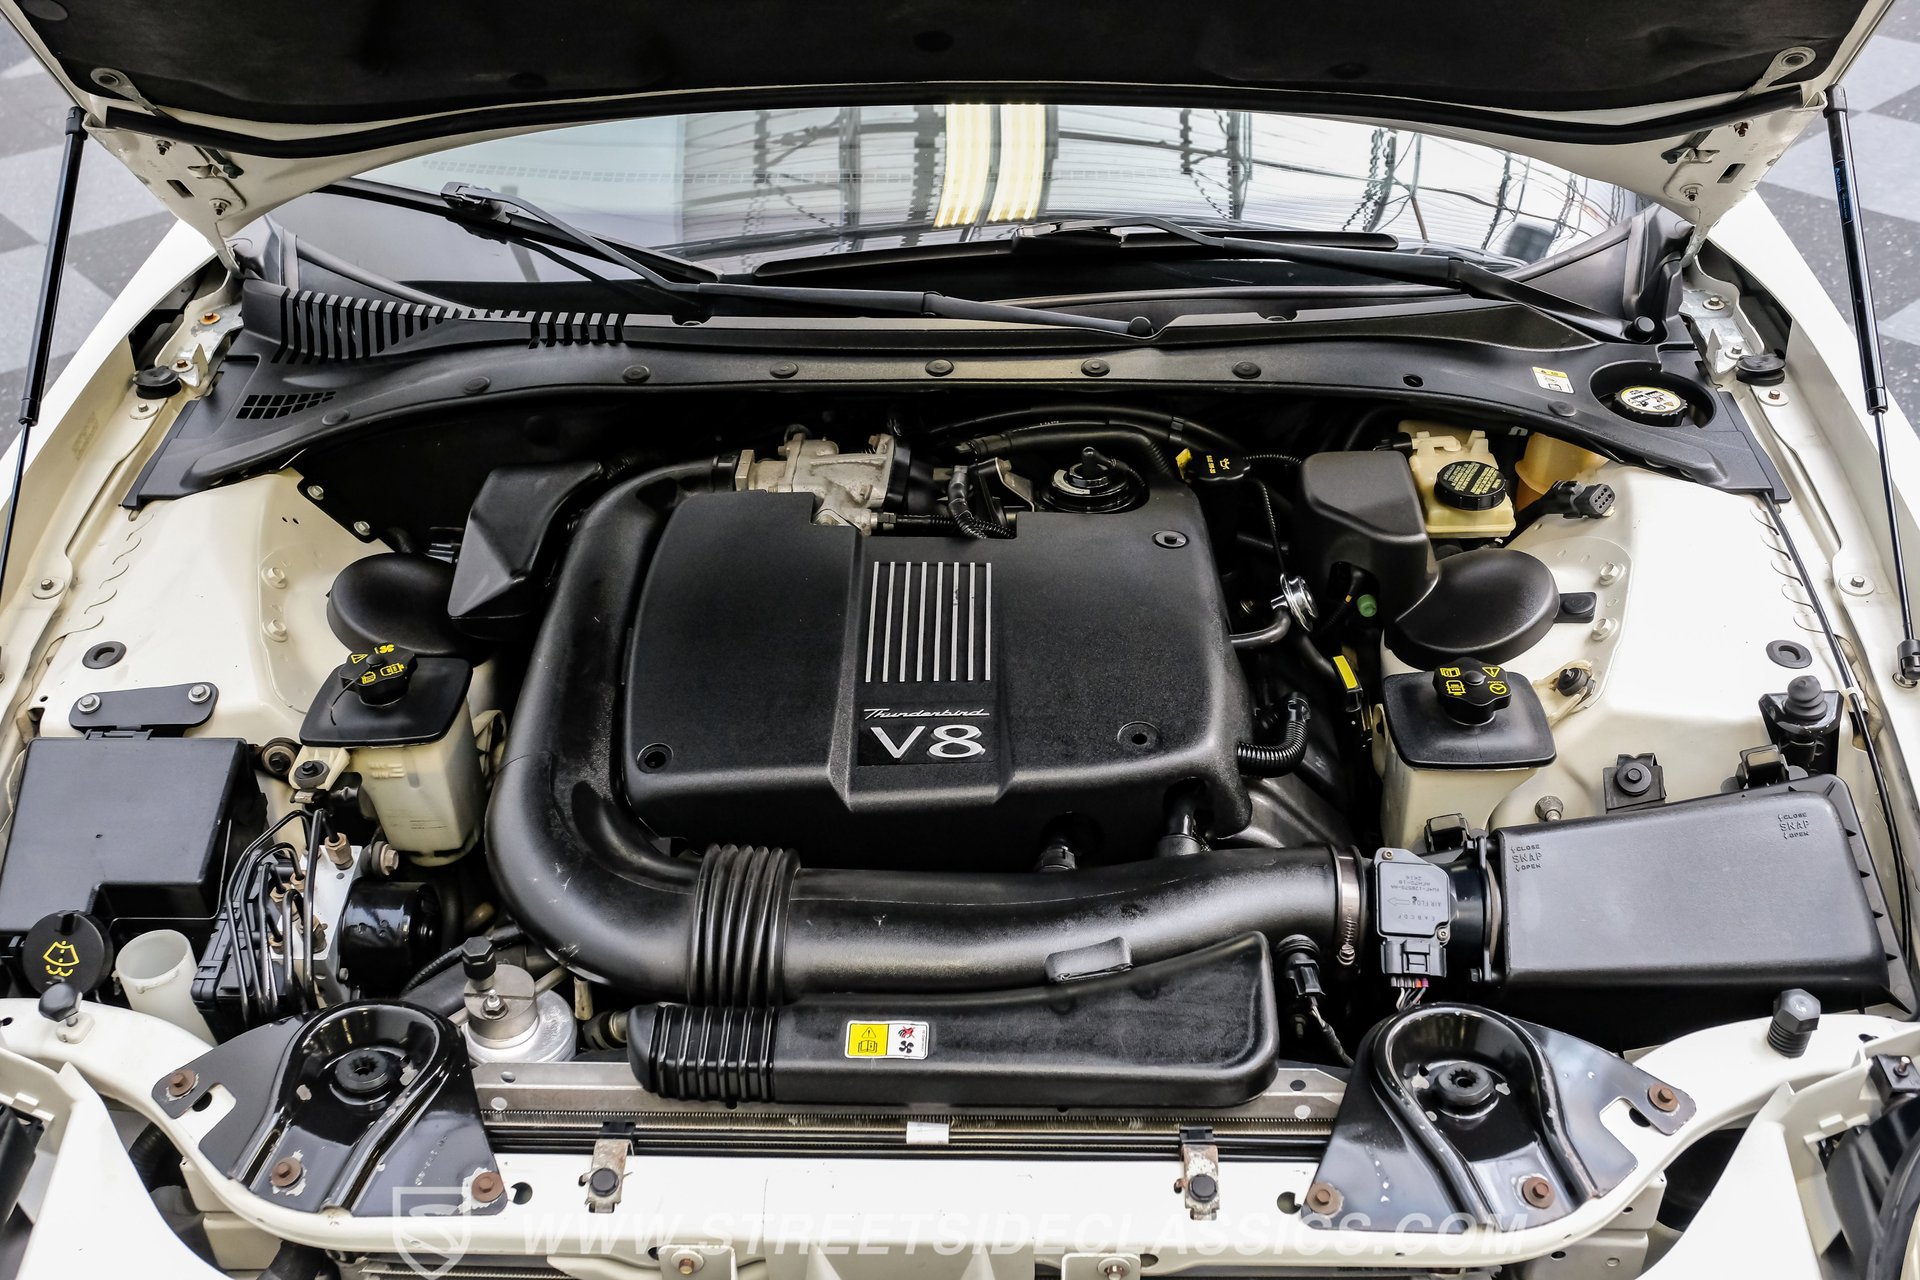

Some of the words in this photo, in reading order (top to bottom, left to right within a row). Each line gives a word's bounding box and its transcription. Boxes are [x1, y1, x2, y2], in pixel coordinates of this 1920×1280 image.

[863, 708, 990, 720] Thunderbird
[870, 724, 985, 758] V8
[1783, 812, 1807, 820] CLOSE
[1779, 820, 1809, 832] SNAP
[1516, 844, 1541, 852] CLOSE
[1511, 852, 1543, 864] SNAP
[1521, 863, 1542, 871] OPEN
